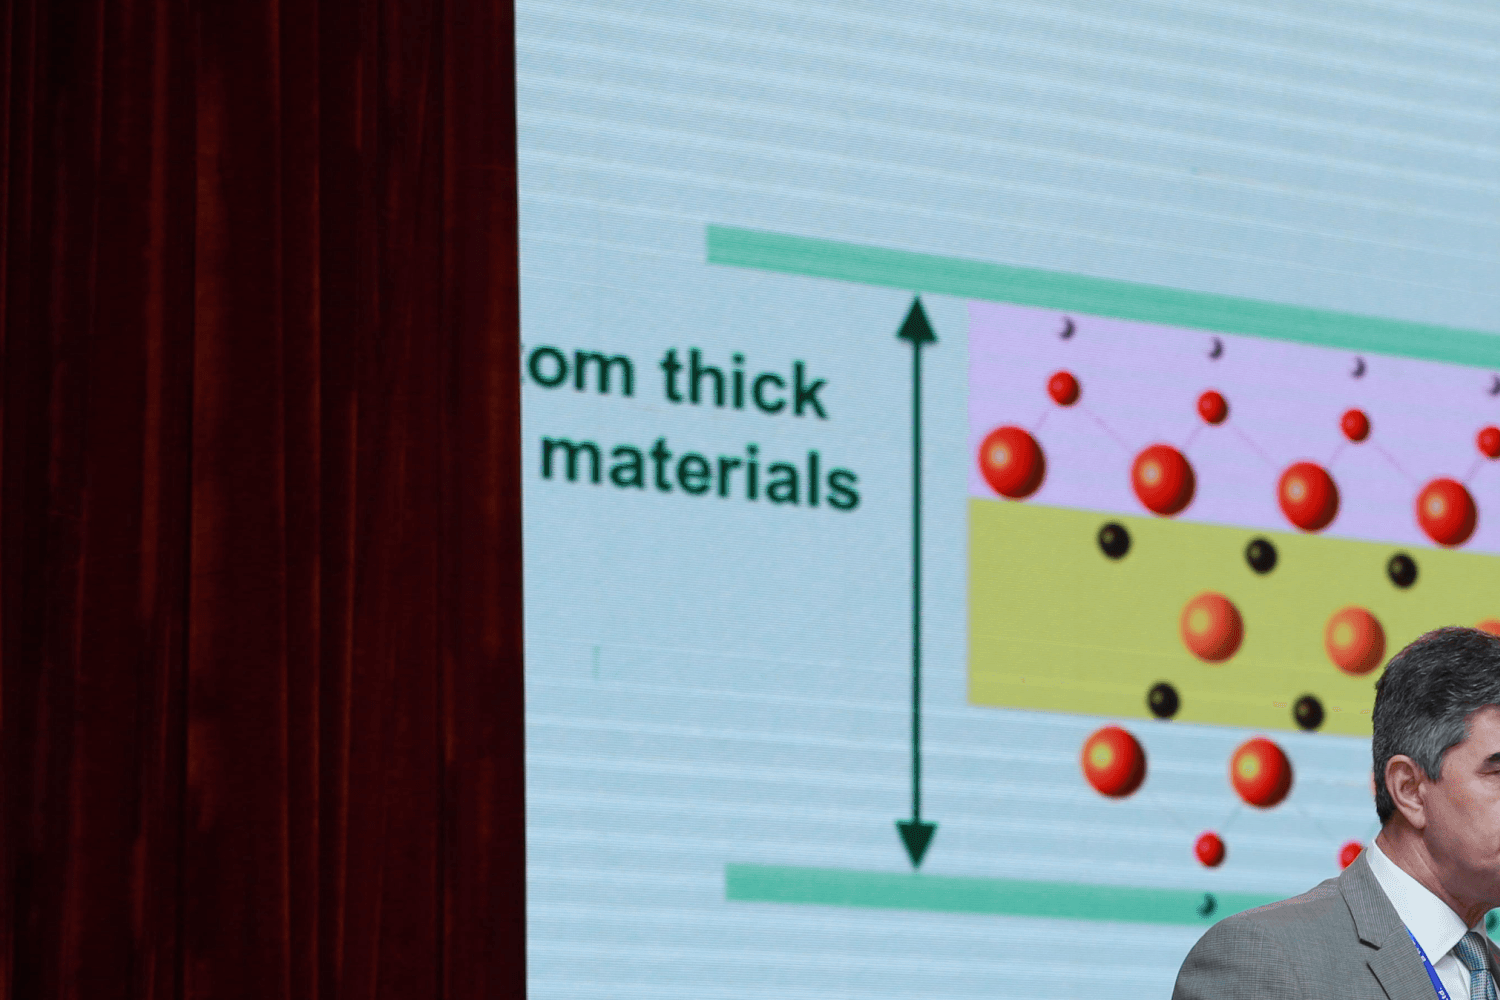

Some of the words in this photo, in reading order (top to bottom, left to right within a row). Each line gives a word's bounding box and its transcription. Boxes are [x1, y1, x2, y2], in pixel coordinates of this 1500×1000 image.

[523, 345, 635, 398] om
[660, 347, 829, 420] thick
[541, 436, 862, 511] materials
